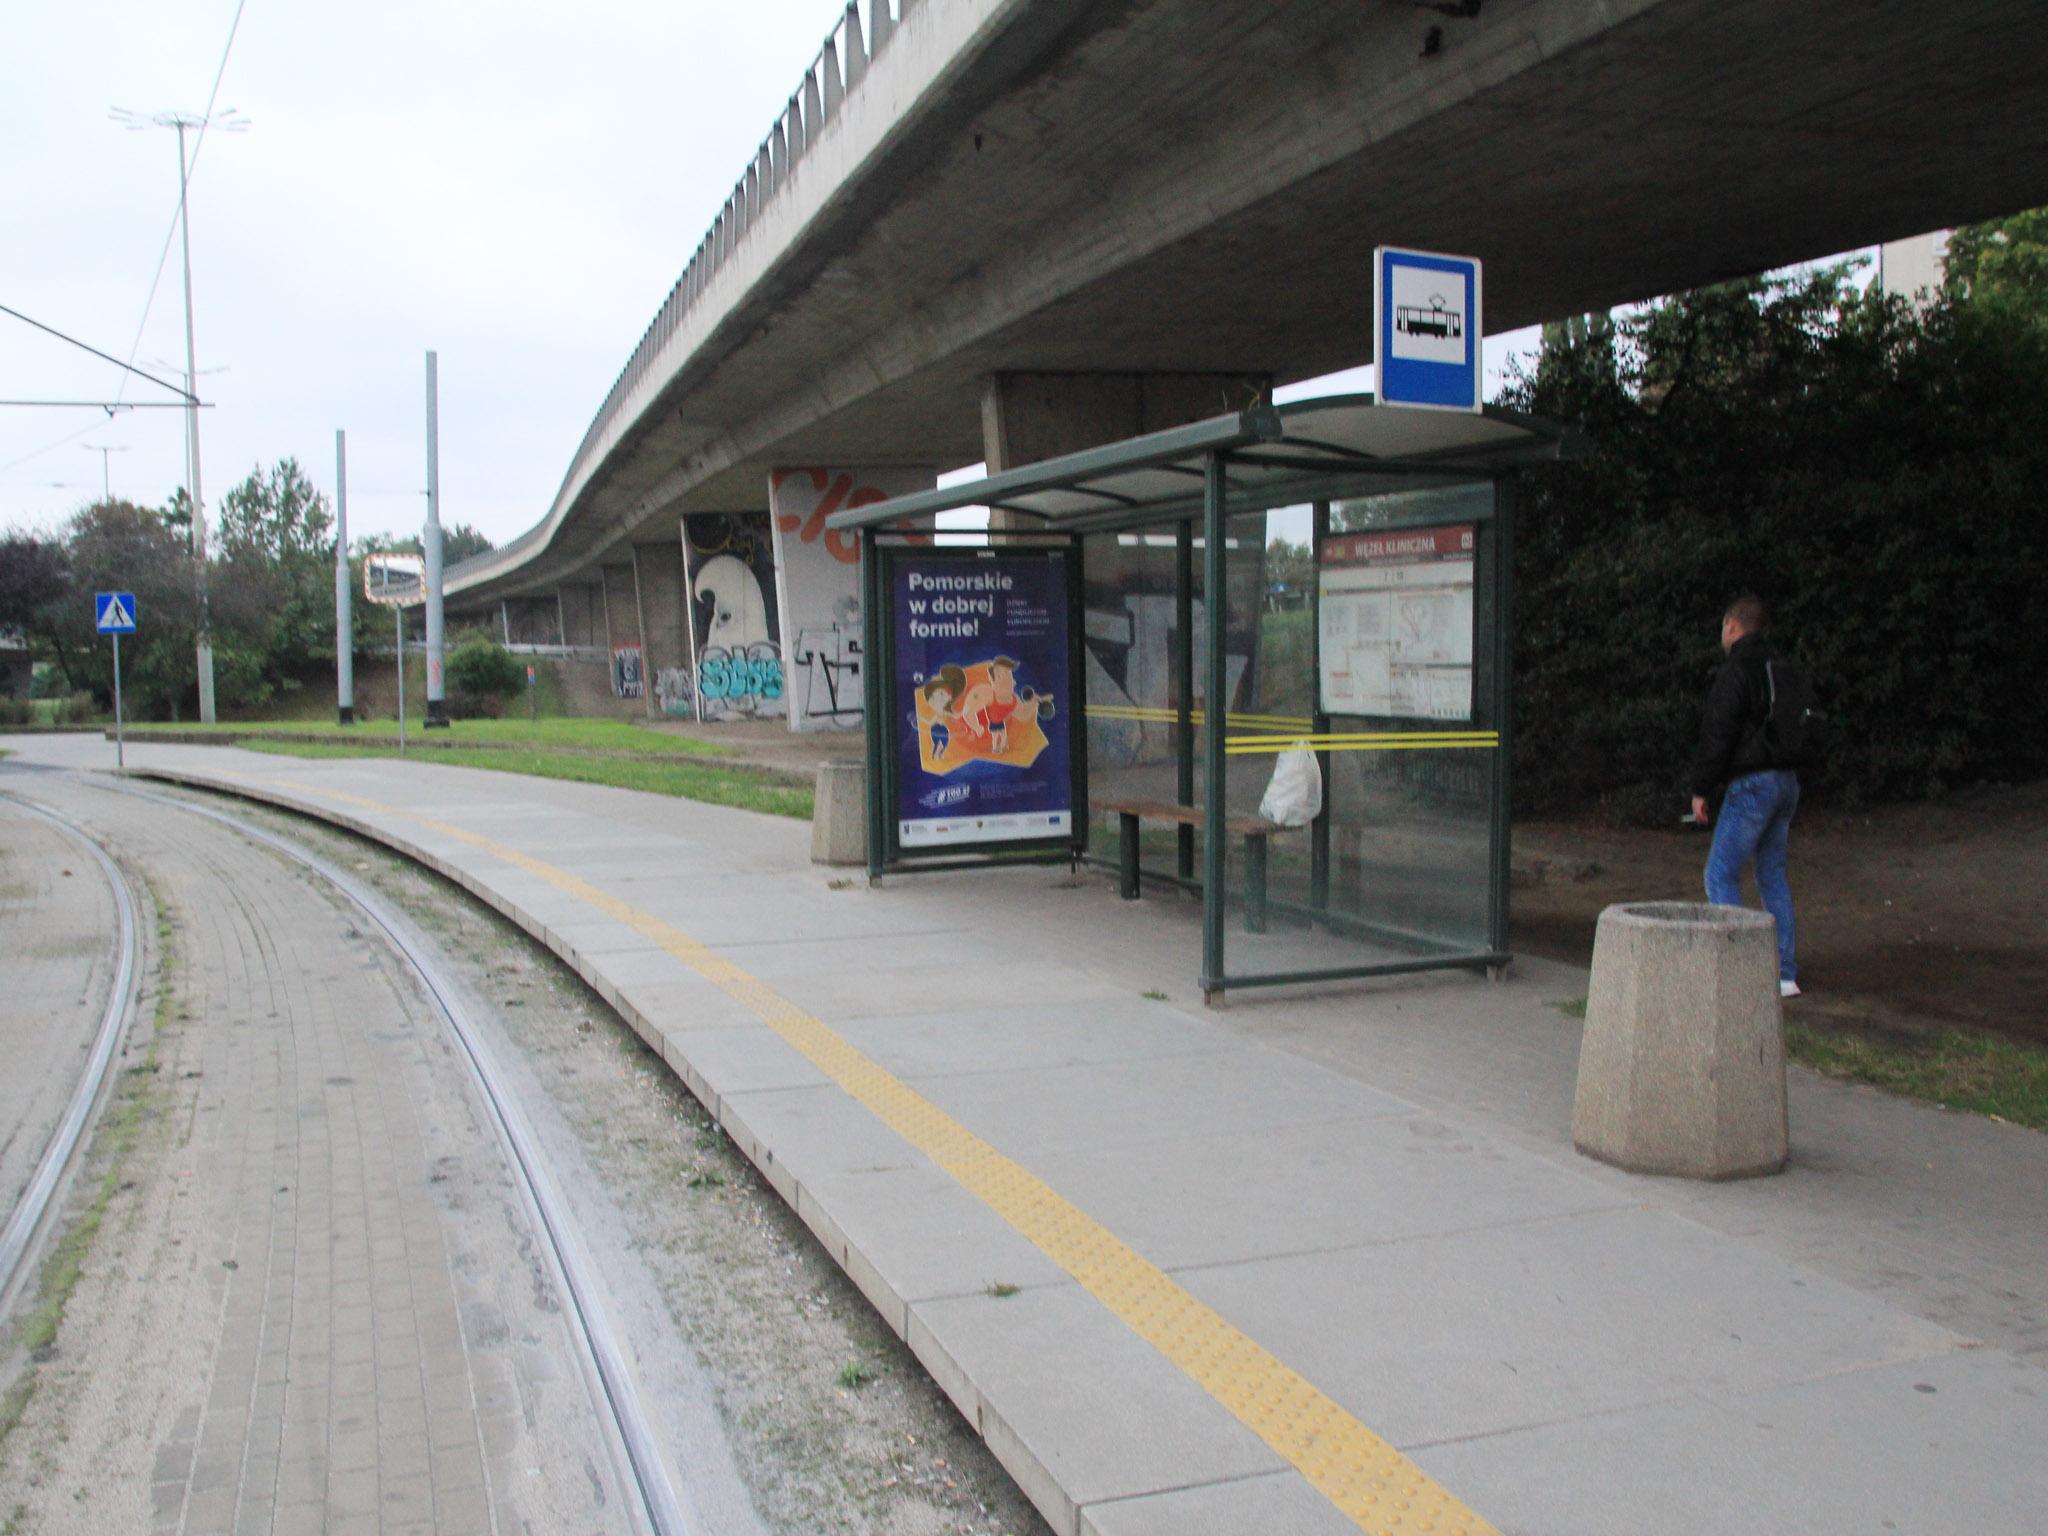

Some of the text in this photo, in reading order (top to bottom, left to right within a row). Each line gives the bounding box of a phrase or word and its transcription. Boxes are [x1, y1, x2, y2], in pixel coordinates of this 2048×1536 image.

[1386, 536, 1435, 553] KLINICZNA
[909, 572, 1013, 591] Pomorskie
[909, 600, 926, 615] w
[932, 596, 994, 617] dobrej
[909, 618, 979, 638] formie!
